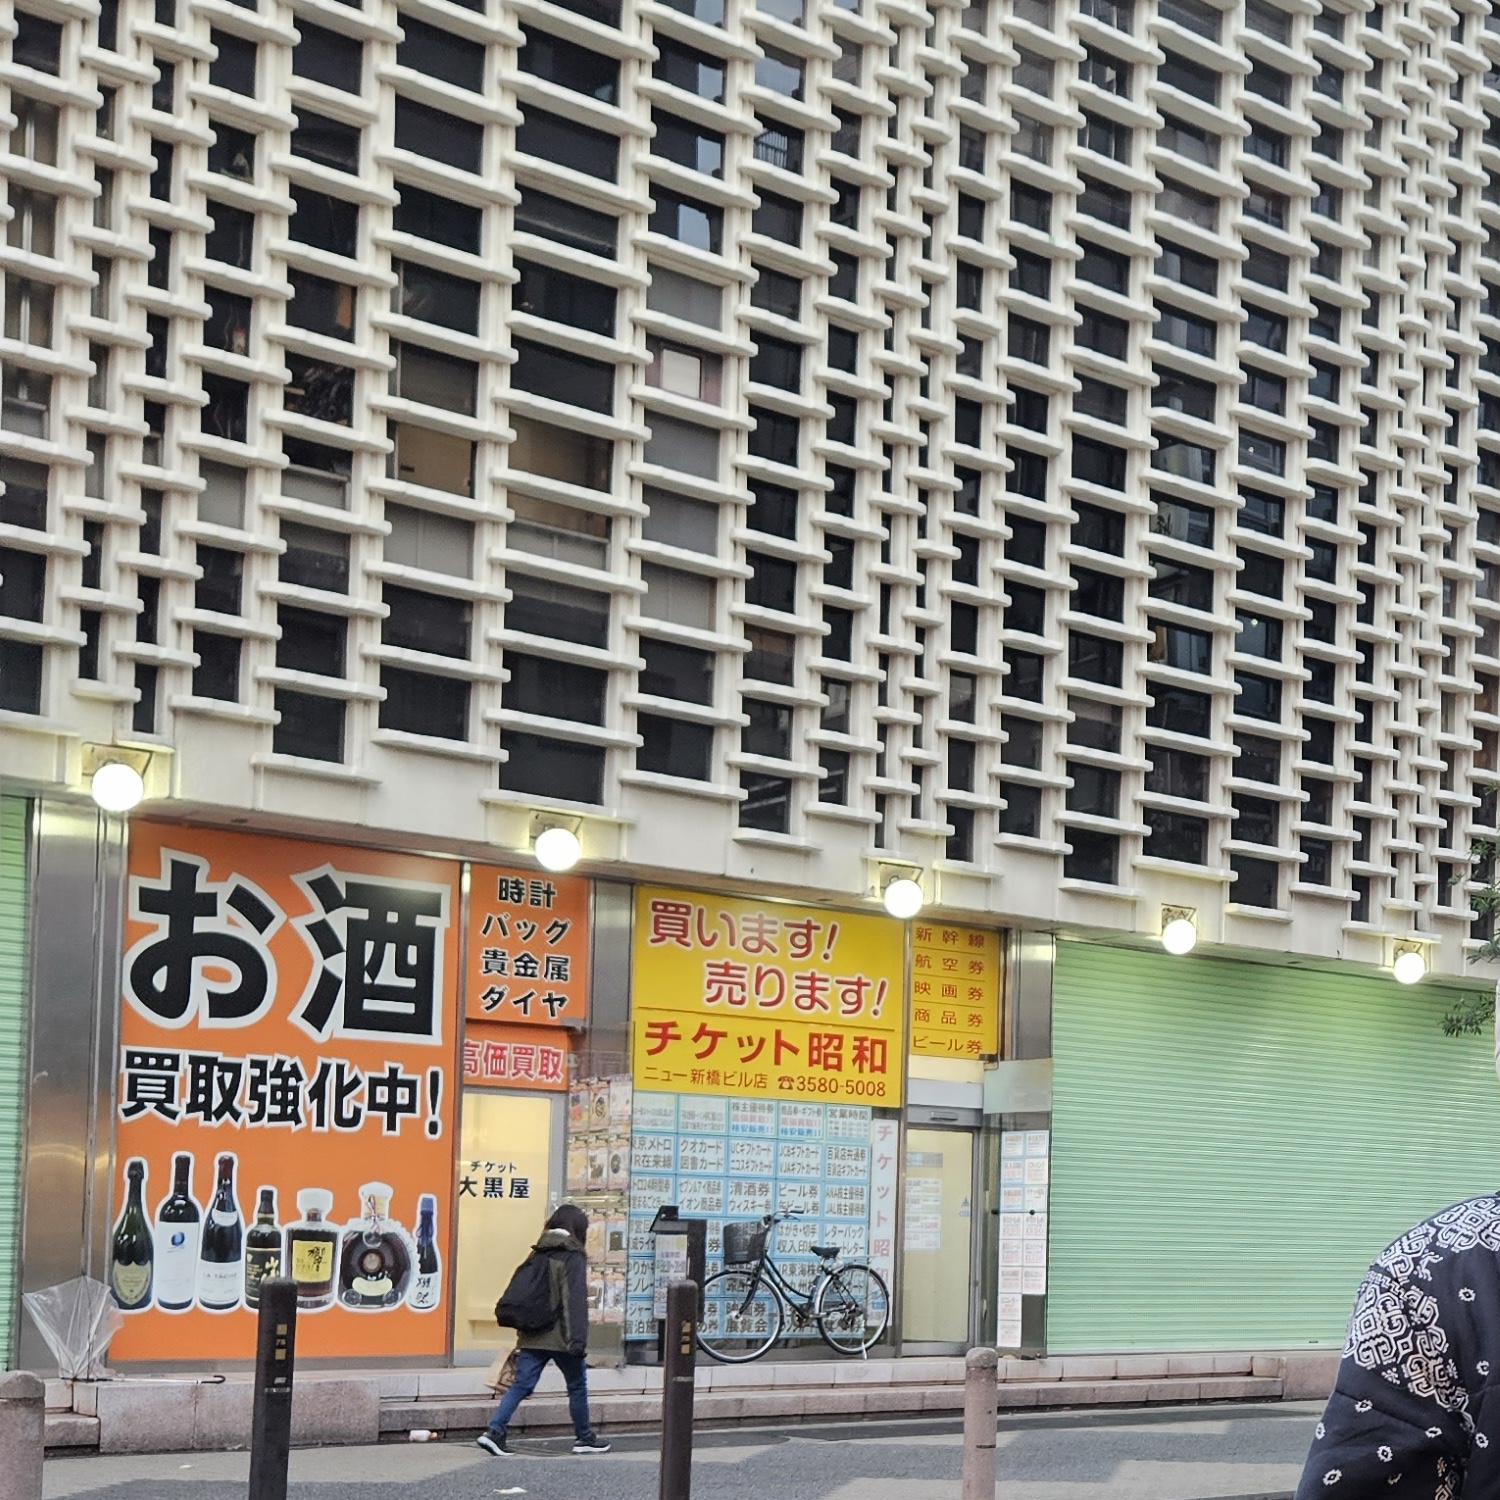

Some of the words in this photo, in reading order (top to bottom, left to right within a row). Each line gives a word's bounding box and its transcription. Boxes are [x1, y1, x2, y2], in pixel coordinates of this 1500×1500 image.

[497, 876, 557, 907] 時計
[481, 911, 572, 946] バッグ
[915, 926, 986, 949] 新幹線
[128, 852, 445, 1038] お酒
[480, 947, 571, 984] 貴金属
[915, 954, 986, 976] 航空券
[480, 984, 568, 1016] ダイヤ
[914, 980, 984, 1001] 映画券
[913, 1007, 983, 1028] 商品券
[644, 1020, 888, 1075] チケット昭和
[913, 1034, 983, 1055] ビール券
[463, 1040, 564, 1083] 高価買取
[644, 1066, 768, 1090] ニュー新橋ビル店
[795, 1075, 887, 1098] 3580-5008
[680, 1139, 723, 1154] クオカード
[471, 1160, 517, 1174] チケット
[633, 1154, 673, 1168] R在来線
[680, 1155, 723, 1170] 図書カード
[459, 1176, 530, 1200] 大黒屋
[730, 1181, 770, 1197] 清酒券
[779, 1184, 818, 1199] ビール券
[825, 1223, 865, 1238] レターパック
